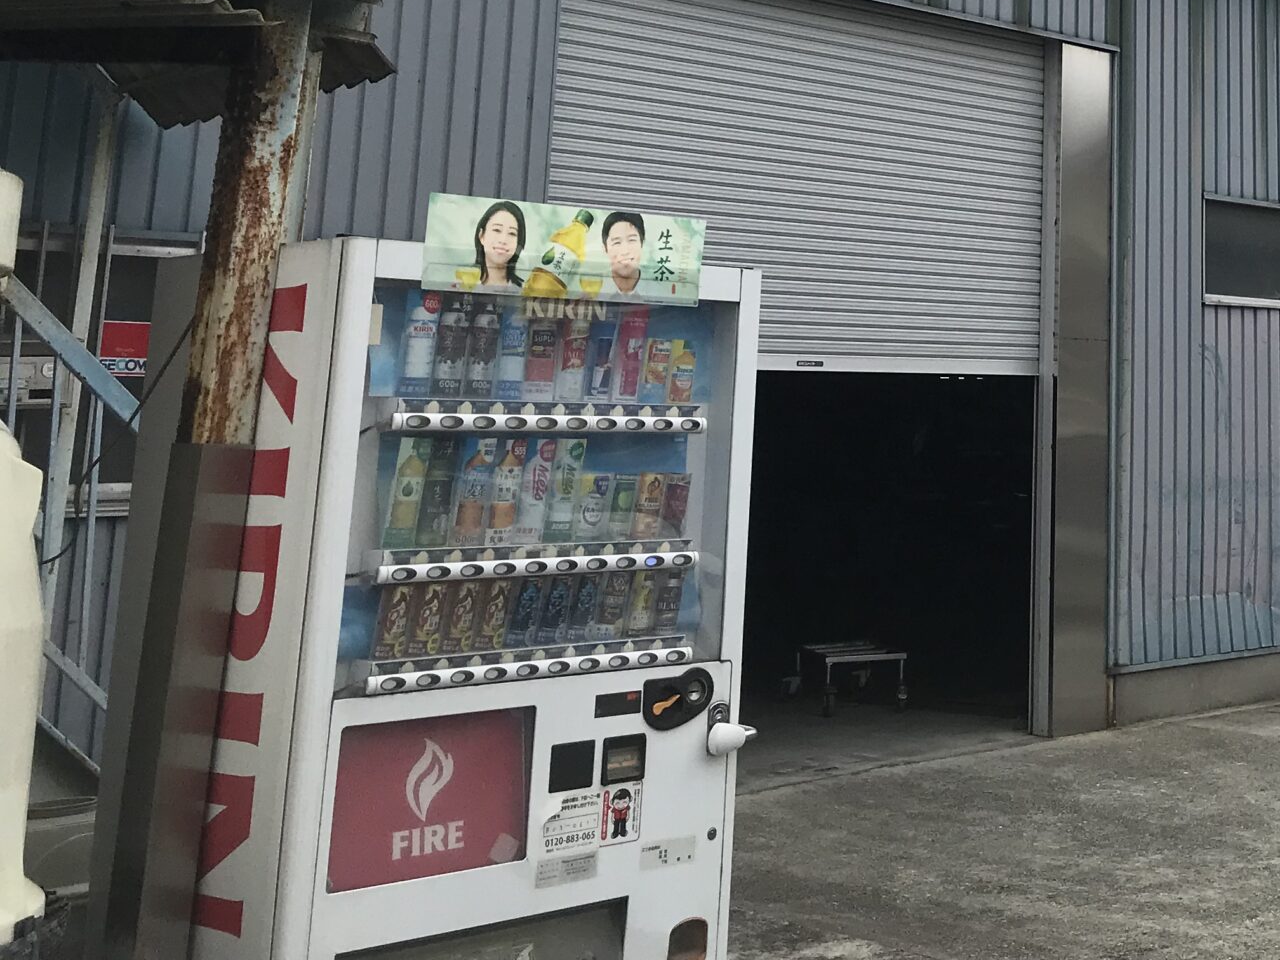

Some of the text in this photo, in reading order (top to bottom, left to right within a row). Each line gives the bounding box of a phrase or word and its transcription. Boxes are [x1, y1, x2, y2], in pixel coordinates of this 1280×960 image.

[654, 228, 676, 283] 生茶
[391, 819, 465, 861] FIRE
[544, 830, 596, 848] 0120-883-065
